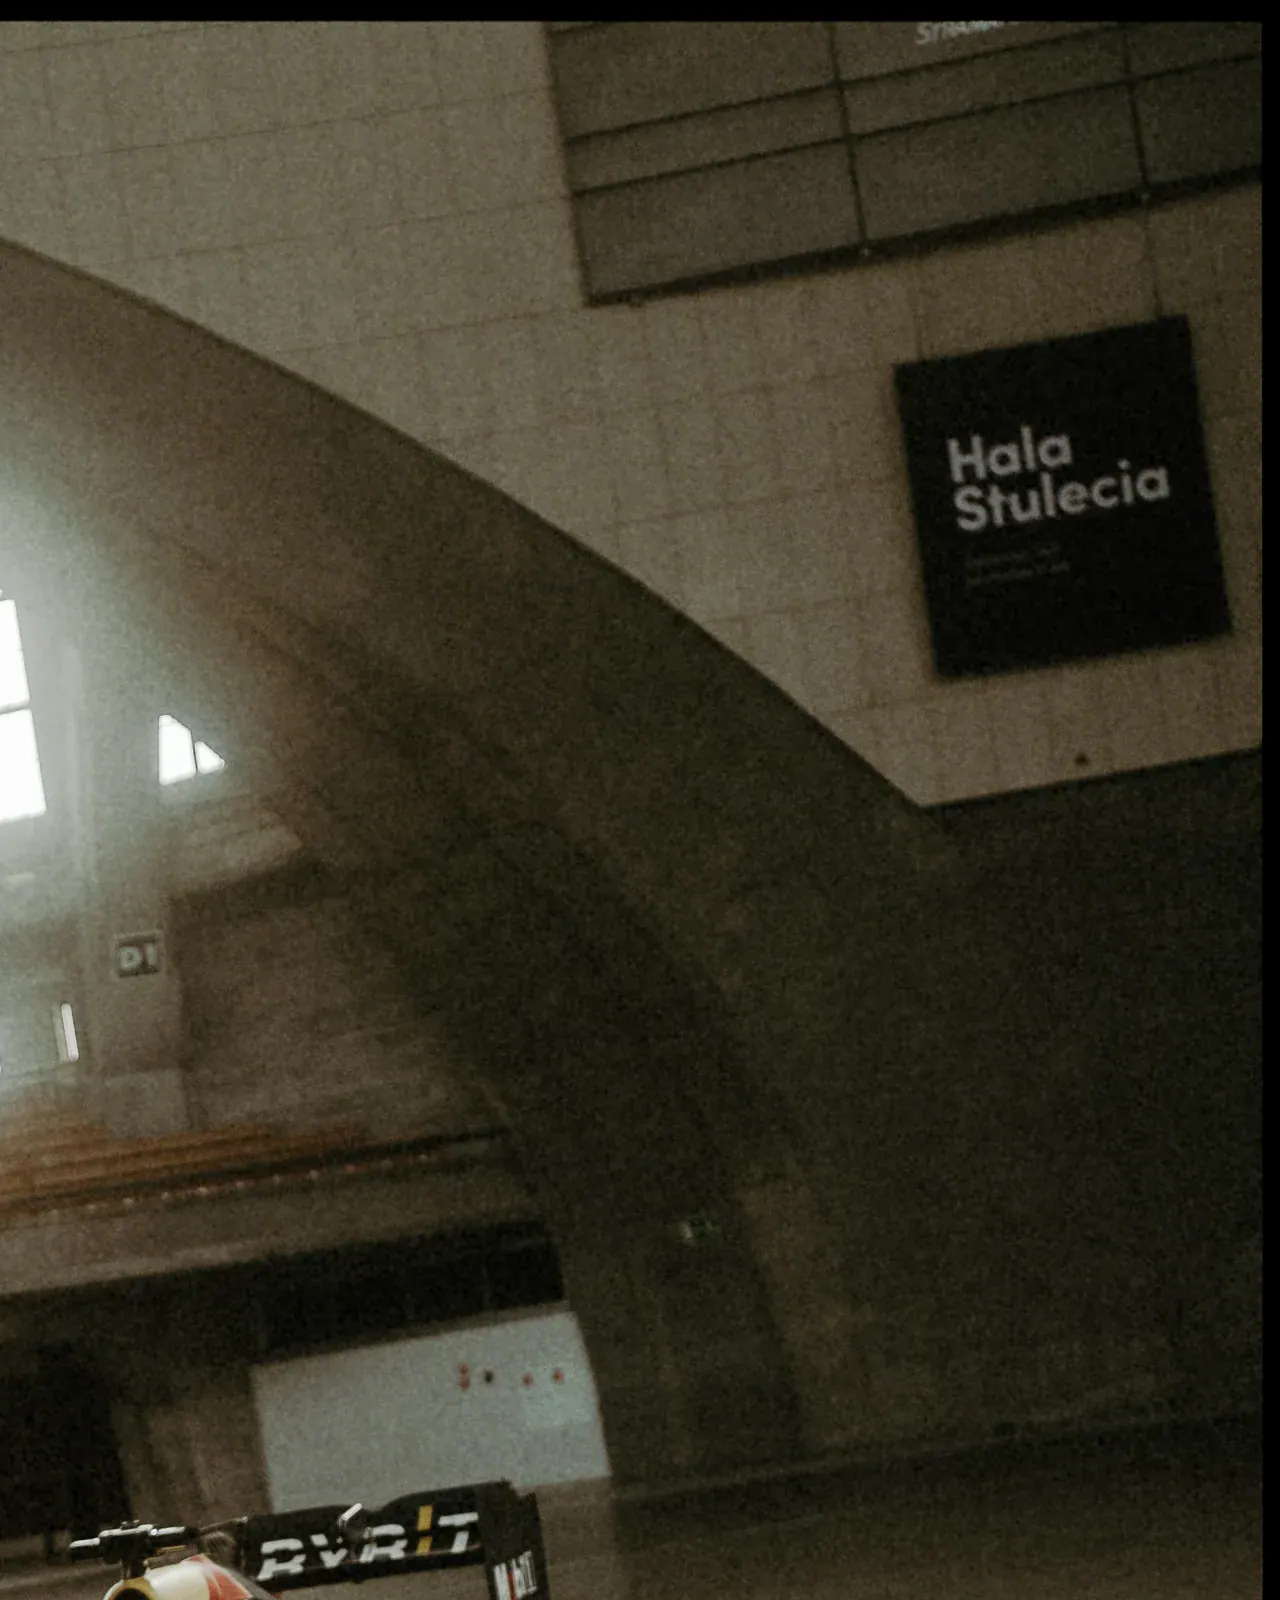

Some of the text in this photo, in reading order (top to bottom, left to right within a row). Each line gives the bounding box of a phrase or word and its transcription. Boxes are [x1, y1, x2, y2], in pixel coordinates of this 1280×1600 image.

[946, 422, 1073, 484] Hala
[953, 458, 1171, 533] Stulecia
[120, 942, 157, 971] D1
